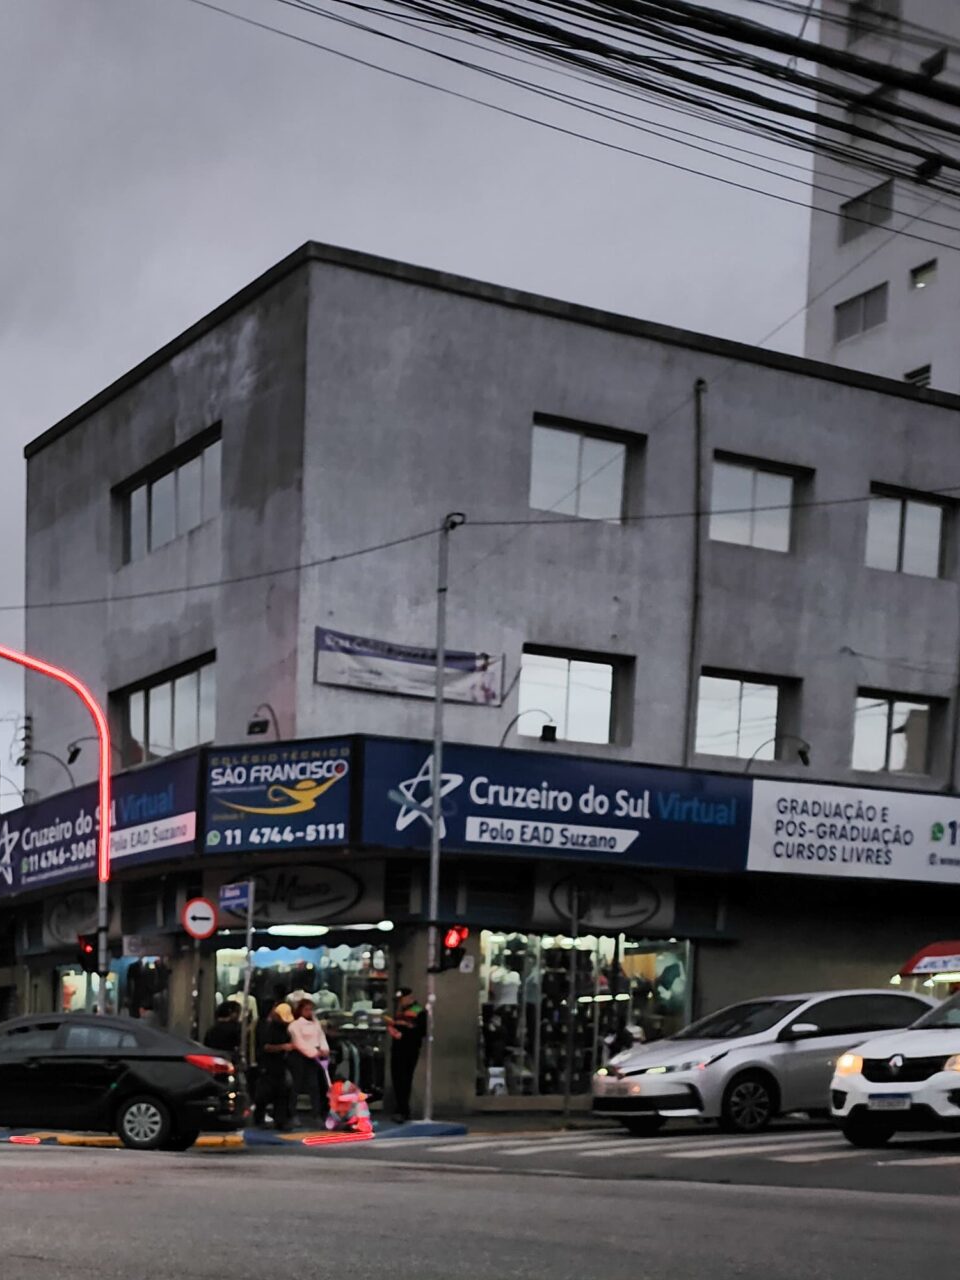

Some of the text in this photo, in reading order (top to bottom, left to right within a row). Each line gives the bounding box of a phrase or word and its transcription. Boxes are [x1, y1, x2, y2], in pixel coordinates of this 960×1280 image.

[250, 759, 348, 783] FRANCISCO
[469, 776, 736, 825] Cruzeiro do Sul Virtual
[776, 797, 889, 823] GRADUAÇÃO E
[21, 816, 72, 851] Cruzeiro
[75, 808, 92, 834] do
[130, 829, 150, 848] EAD
[224, 823, 345, 846] 11 4744-5111
[478, 821, 617, 849] Polo EAD Suzano
[774, 819, 914, 846] PÓS-GRADUAÇÃO
[773, 841, 892, 866] CURSOS LIVRES
